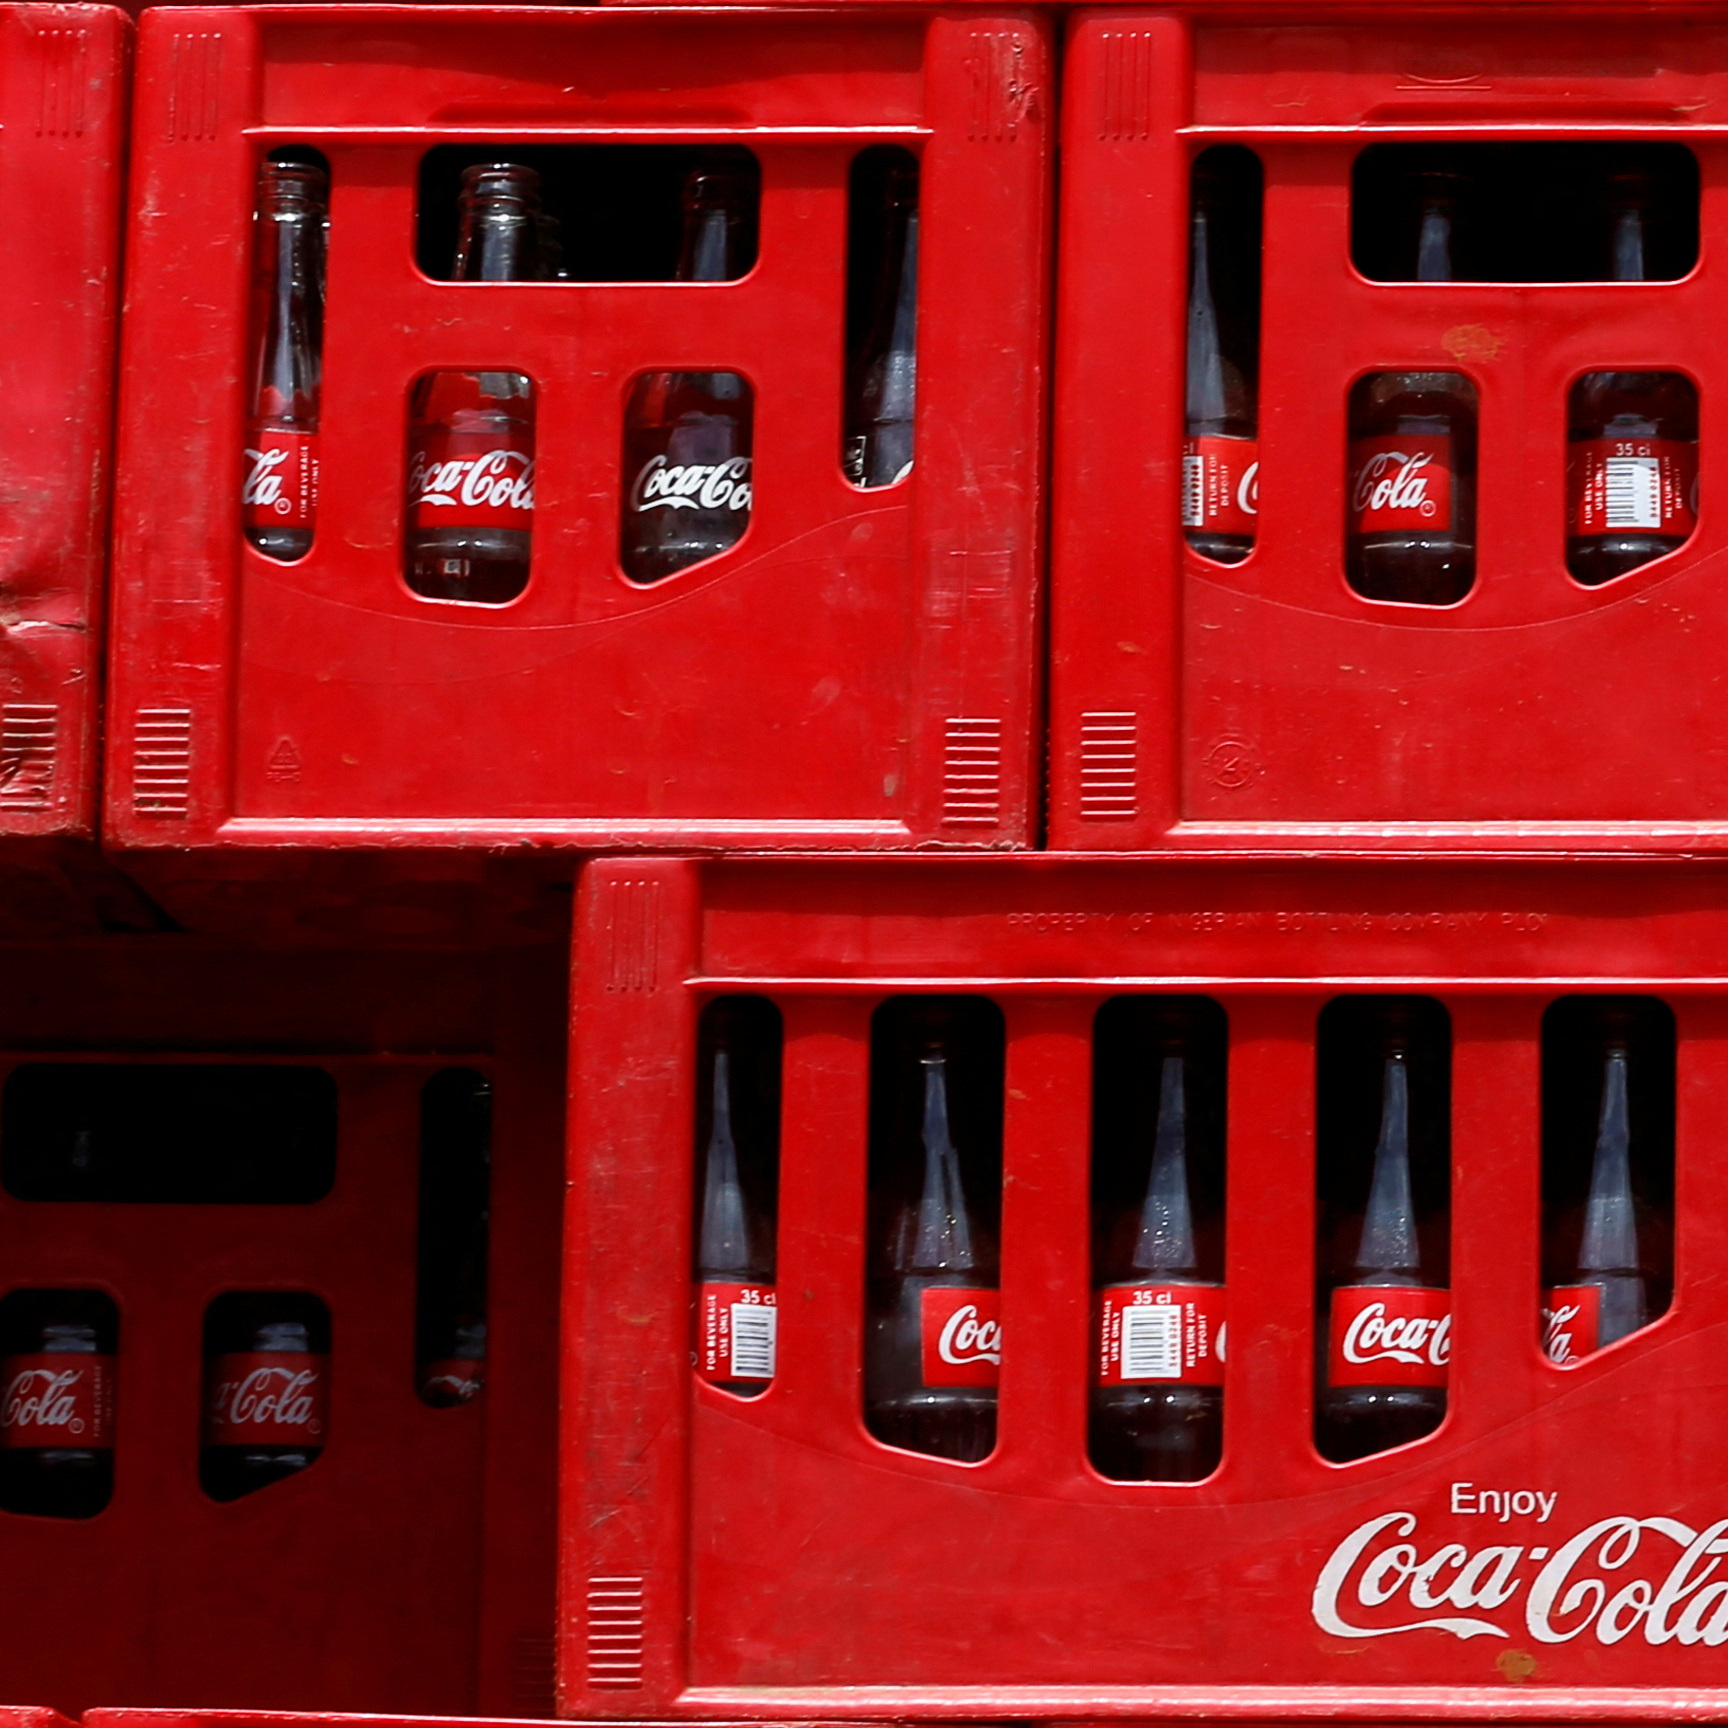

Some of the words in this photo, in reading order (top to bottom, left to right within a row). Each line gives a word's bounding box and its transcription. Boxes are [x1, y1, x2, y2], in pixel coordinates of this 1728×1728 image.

[1615, 443, 1634, 456] 35
[300, 445, 309, 493] BEVERAGE
[1208, 454, 1217, 476] FOR
[300, 496, 308, 518] FOR
[1208, 478, 1218, 517] RETURN
[1595, 489, 1604, 511] USE
[1584, 504, 1593, 525] FOR
[1006, 911, 1115, 933] PROPERTY
[741, 1289, 760, 1304] 35
[763, 1292, 777, 1305] cl
[1132, 1290, 1153, 1305] 35
[1156, 1291, 1172, 1305] cl
[707, 1294, 717, 1348] BEVERAGE
[720, 1308, 729, 1334] ONLY
[1186, 1303, 1196, 1323] FOR
[1102, 1301, 1112, 1352] BEVERAGE
[1112, 1312, 1120, 1338] ONLY
[1198, 1314, 1207, 1358] DEPOSIT
[719, 1337, 728, 1358] USE
[1110, 1342, 1119, 1362] USE
[1186, 1325, 1196, 1368] RETURN
[707, 1350, 716, 1371] FOR
[1101, 1355, 1109, 1376] FOR
[1452, 1482, 1557, 1523] Enjoy
